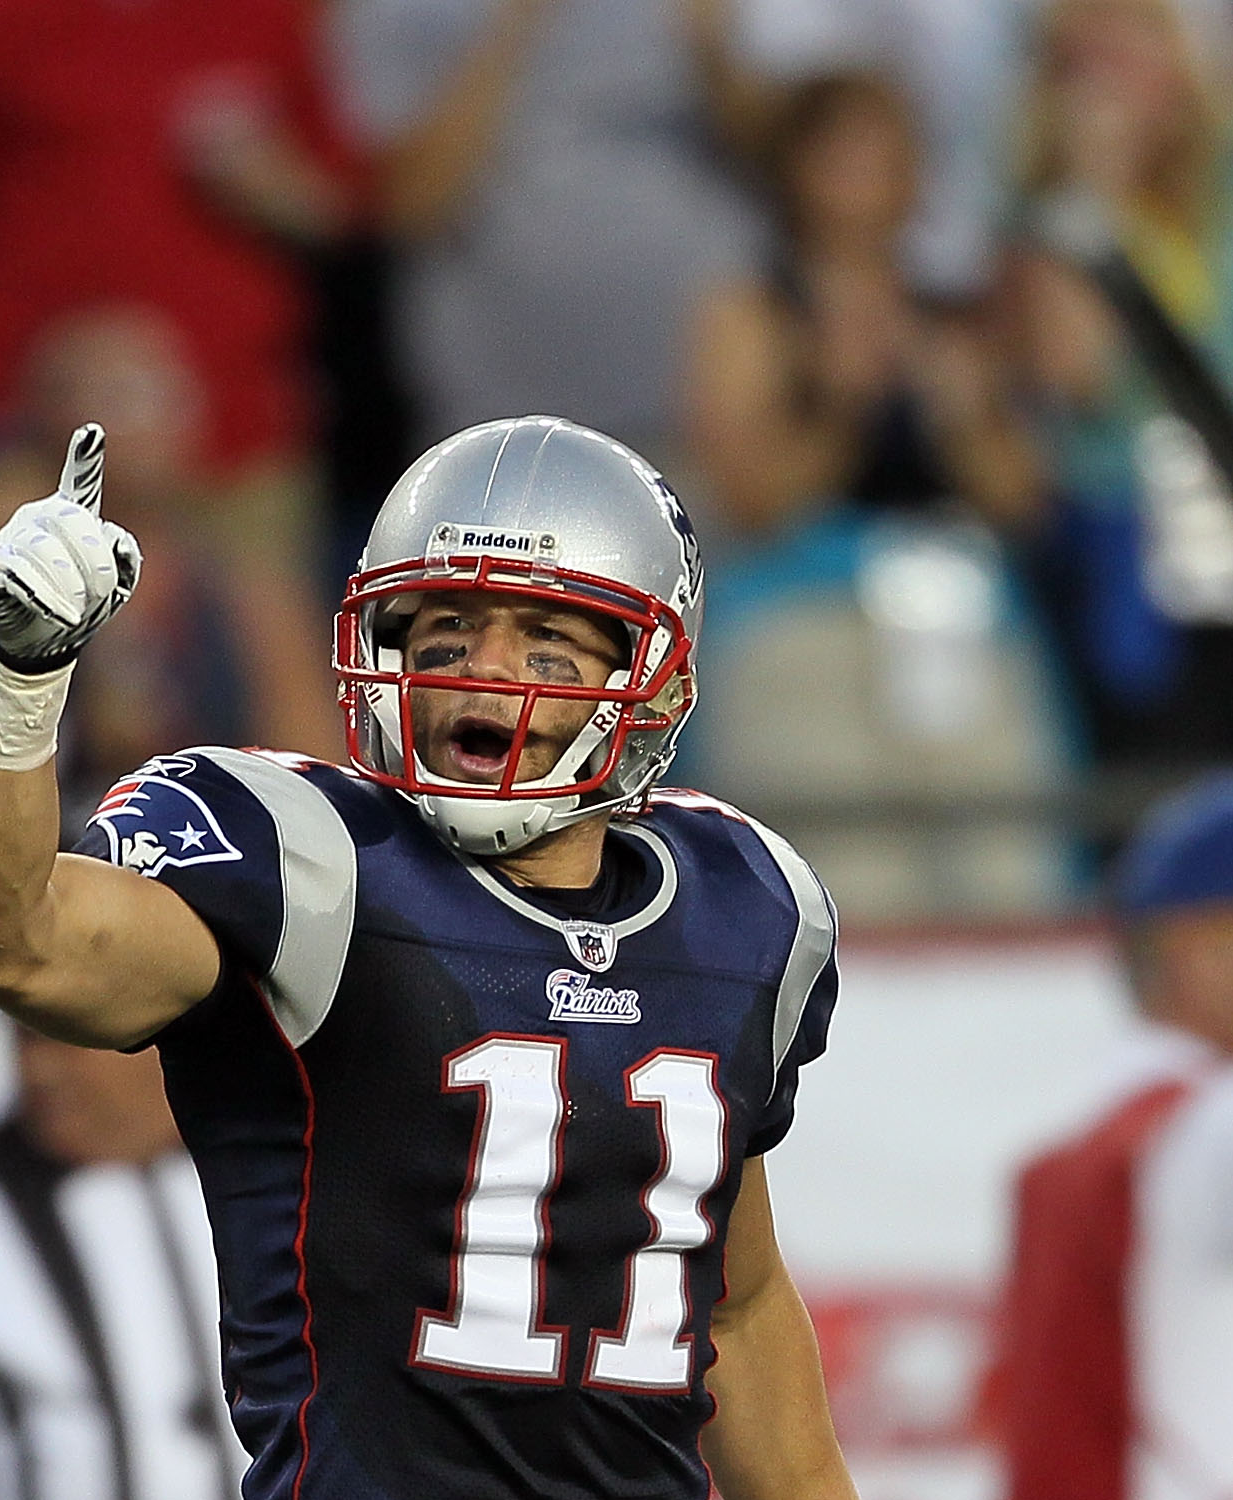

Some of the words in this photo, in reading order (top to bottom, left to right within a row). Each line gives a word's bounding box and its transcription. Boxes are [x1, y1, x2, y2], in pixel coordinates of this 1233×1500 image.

[462, 532, 530, 551] Riddell
[549, 981, 639, 1022] Patriots
[408, 1031, 730, 1396] 11
